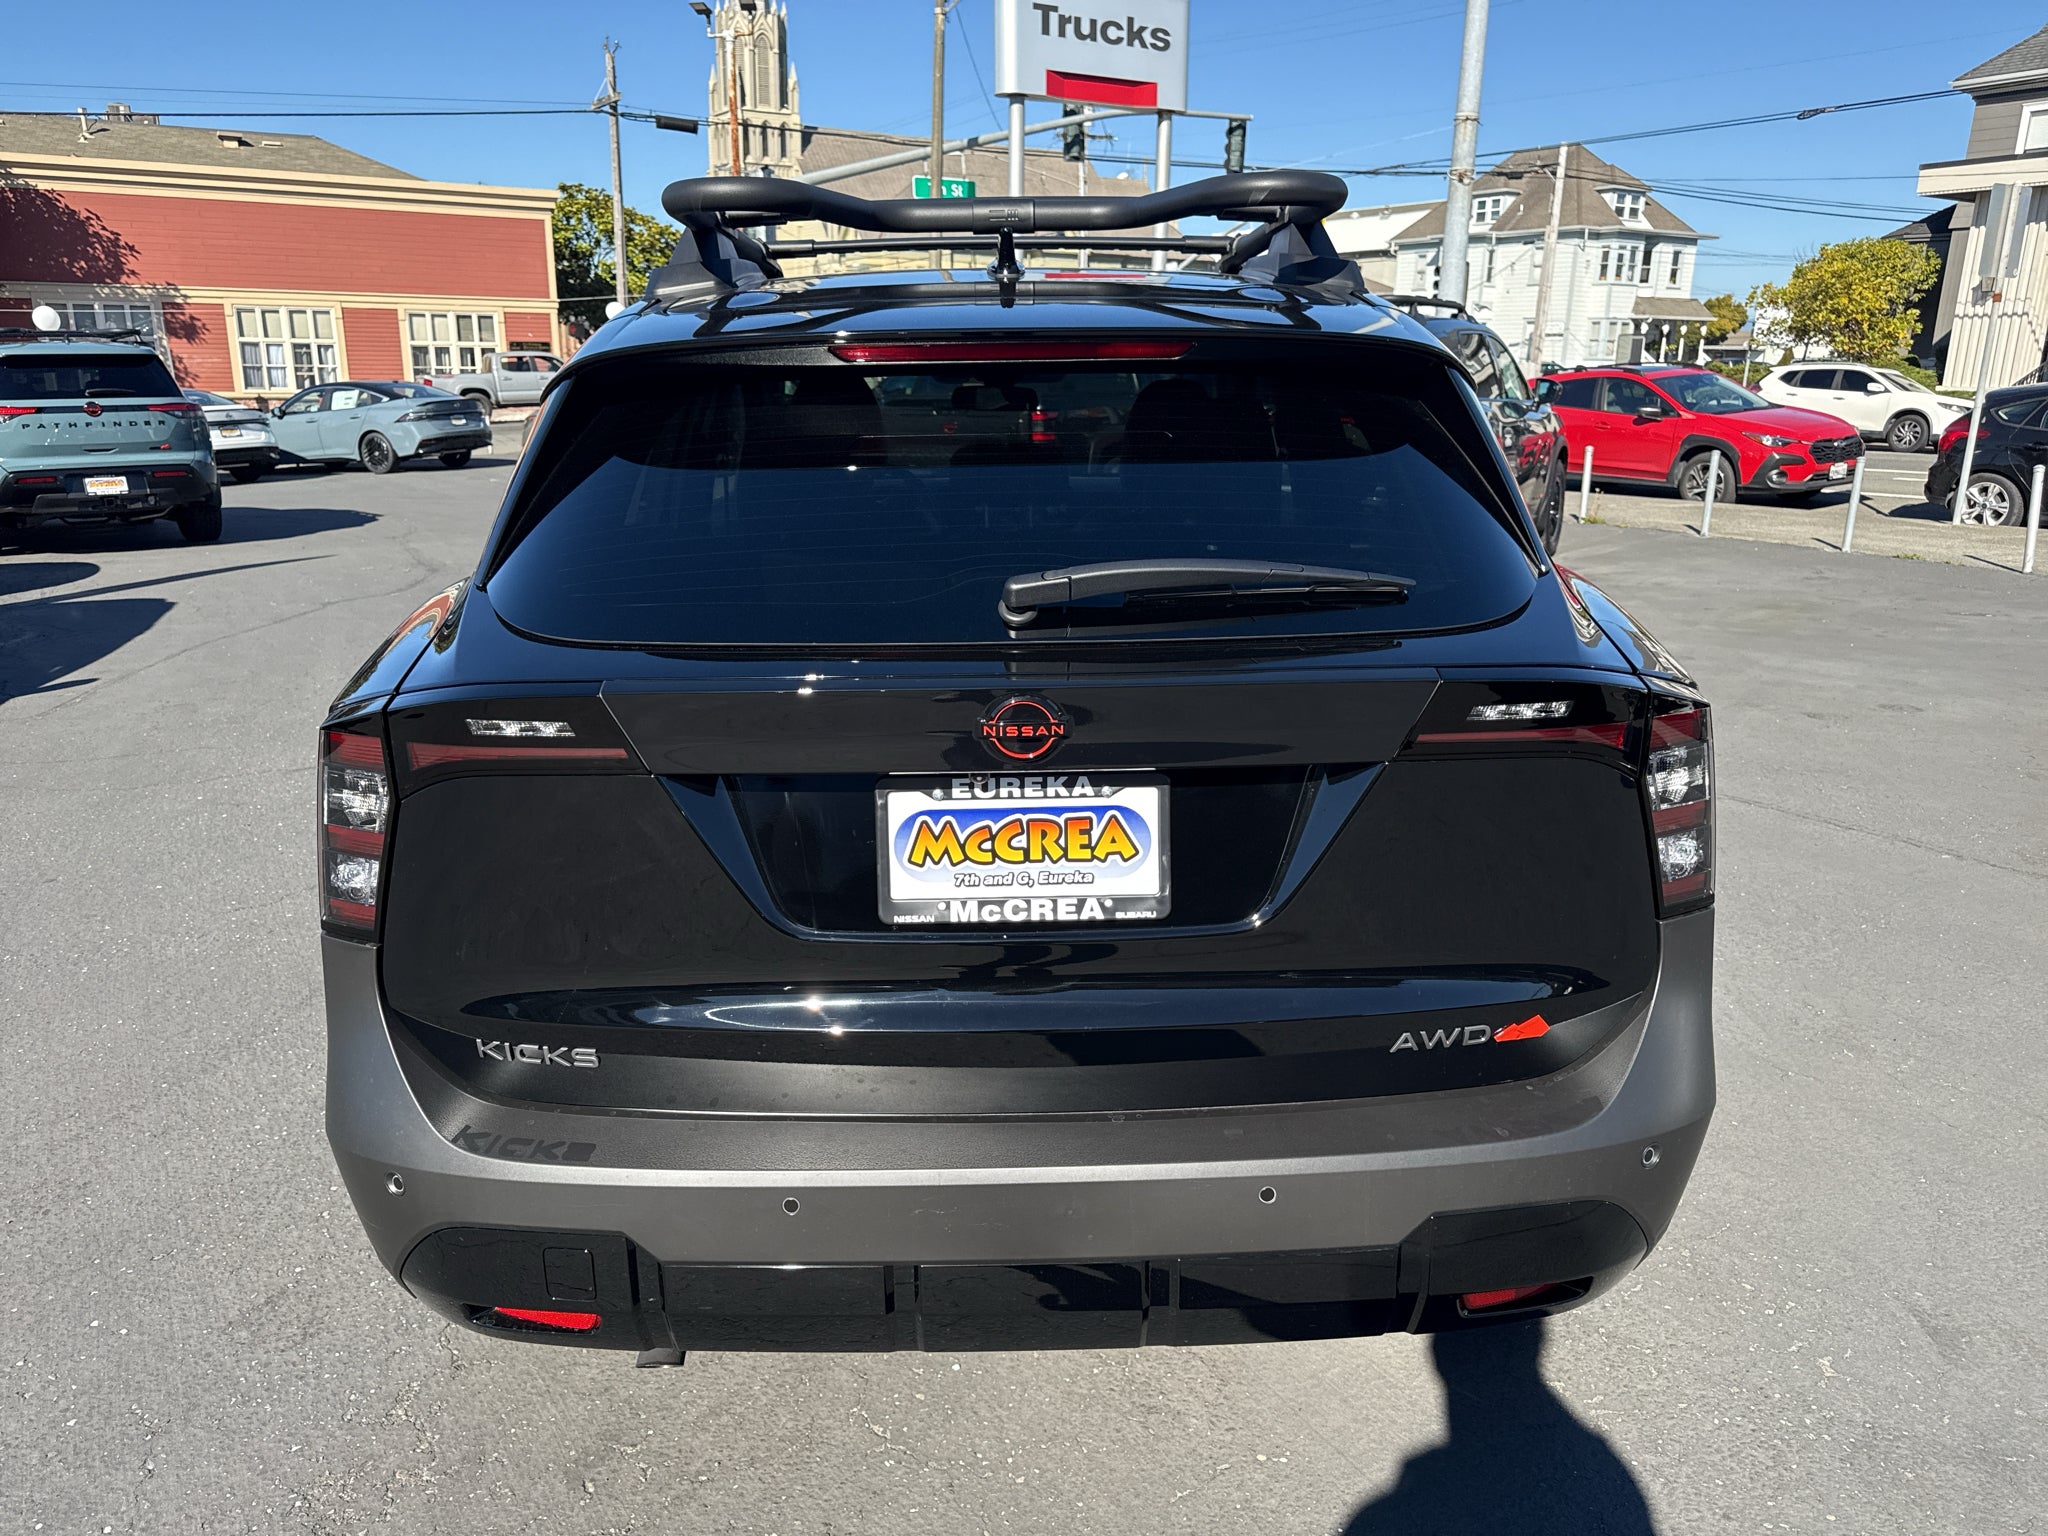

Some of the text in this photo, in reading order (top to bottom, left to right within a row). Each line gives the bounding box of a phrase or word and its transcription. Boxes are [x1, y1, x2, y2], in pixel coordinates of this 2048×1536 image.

[1032, 2, 1172, 53] Trucks
[21, 420, 166, 430] PATHFINDER
[983, 725, 1064, 737] NISSAN
[951, 775, 1095, 799] EUREKA
[954, 870, 1095, 888] 7th and G, Eureka
[893, 915, 935, 923] NISSAN
[1389, 1024, 1492, 1053] AWD
[475, 1038, 600, 1069] KICKS
